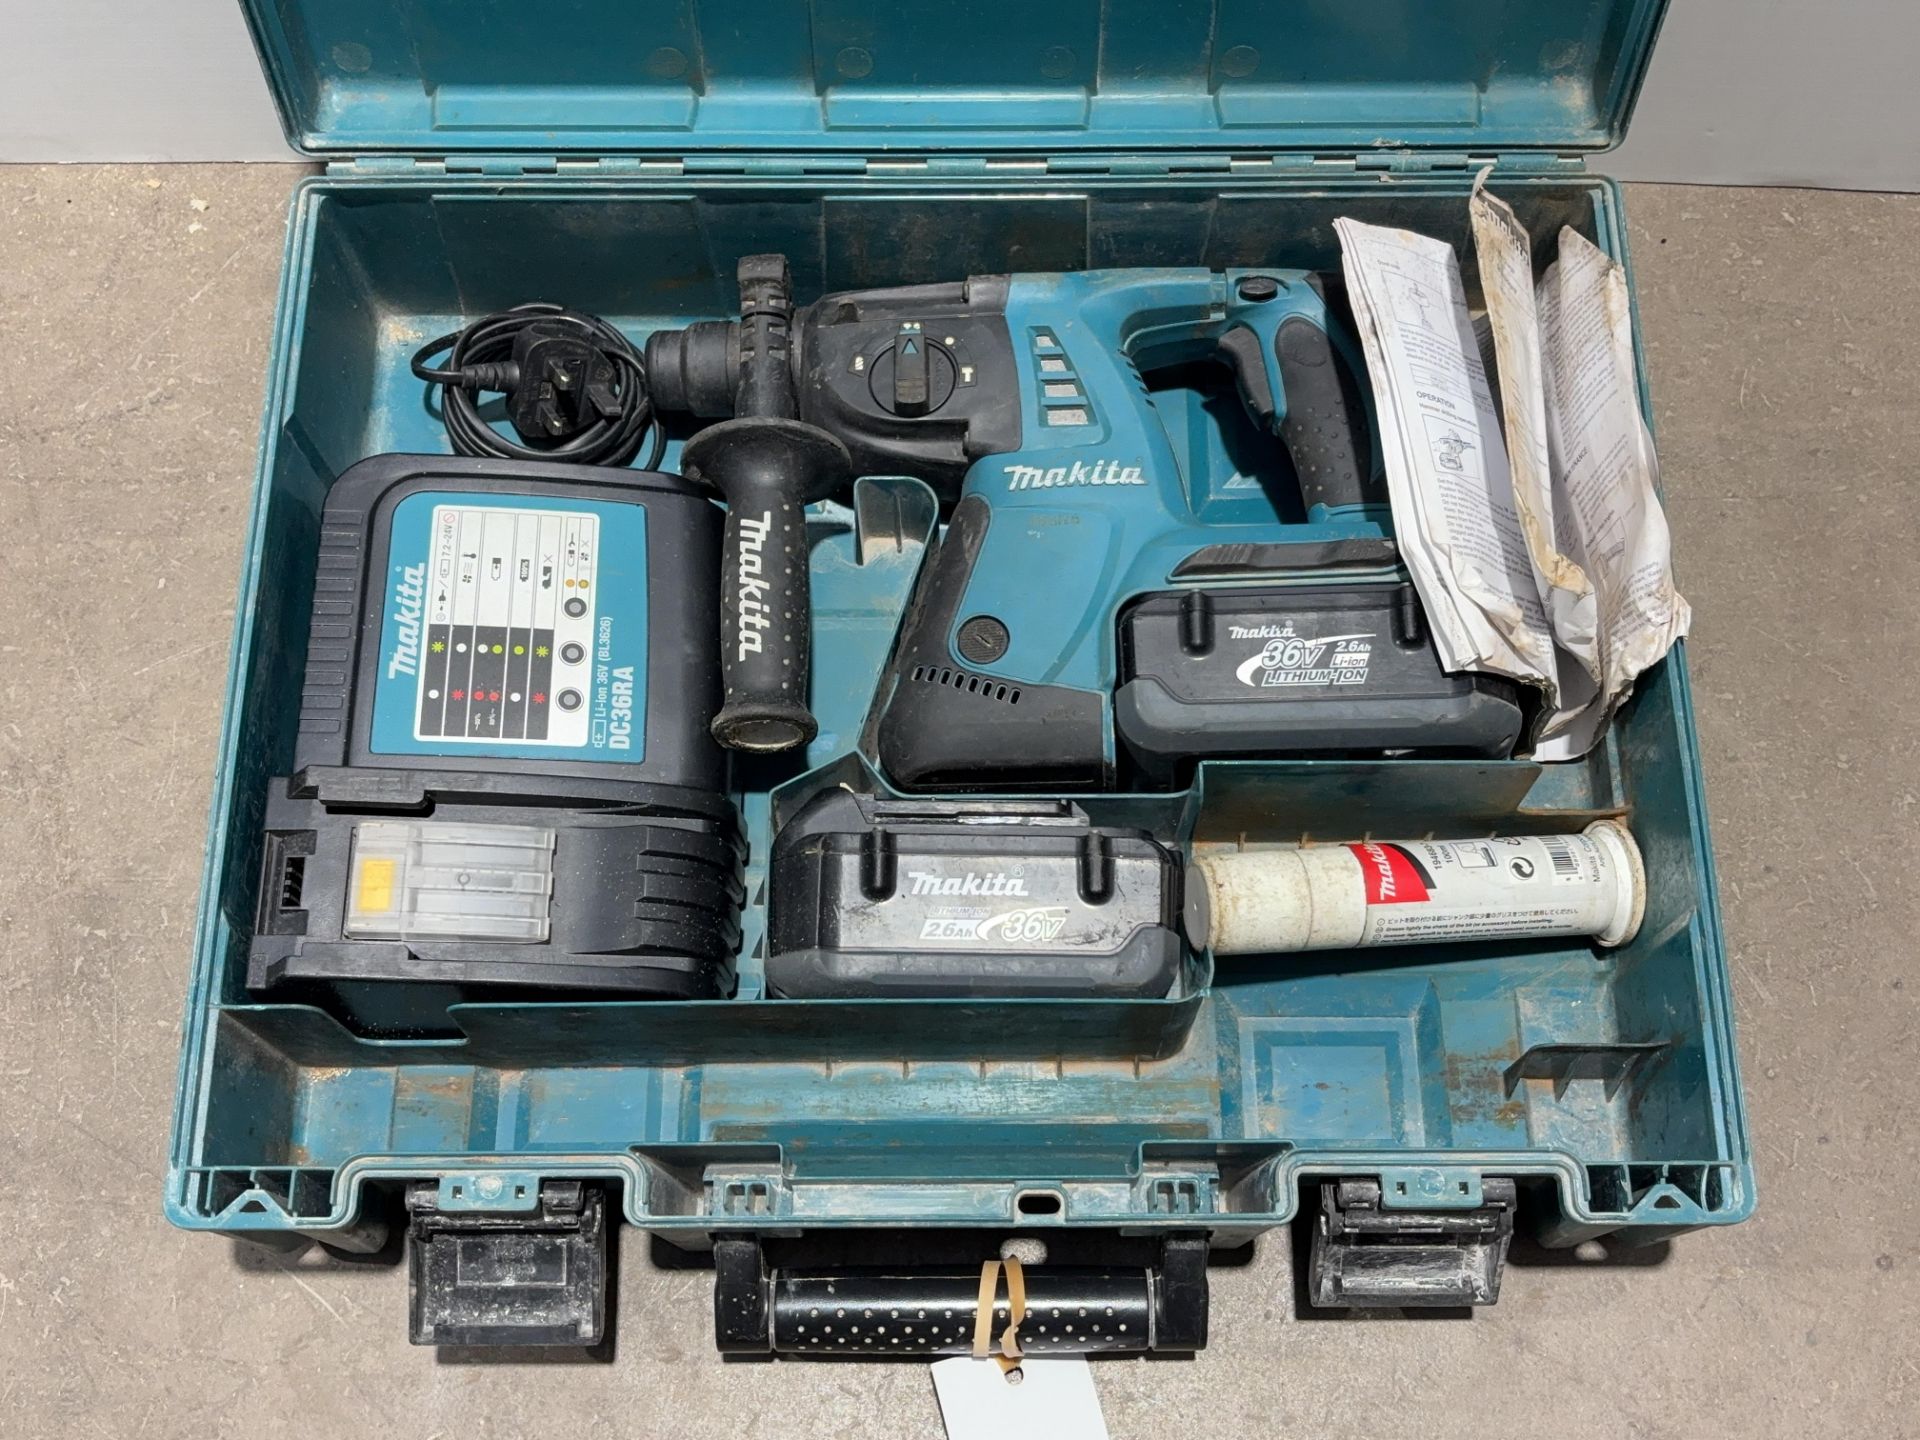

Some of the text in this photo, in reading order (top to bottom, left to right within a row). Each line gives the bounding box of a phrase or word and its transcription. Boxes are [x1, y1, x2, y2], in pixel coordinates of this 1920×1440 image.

[1004, 459, 1146, 492] Makita
[737, 510, 772, 663] Makita
[387, 562, 425, 680] Makita
[1228, 624, 1297, 639] Makita
[596, 616, 614, 717] Li-ion 36V (BL3626)
[1262, 638, 1372, 669] 36V 2.6Ah
[1333, 656, 1367, 667] Li-ion
[609, 666, 635, 750] DC36RA
[908, 869, 1029, 897] Makita
[925, 911, 1067, 942] 2.6Ah 36V
